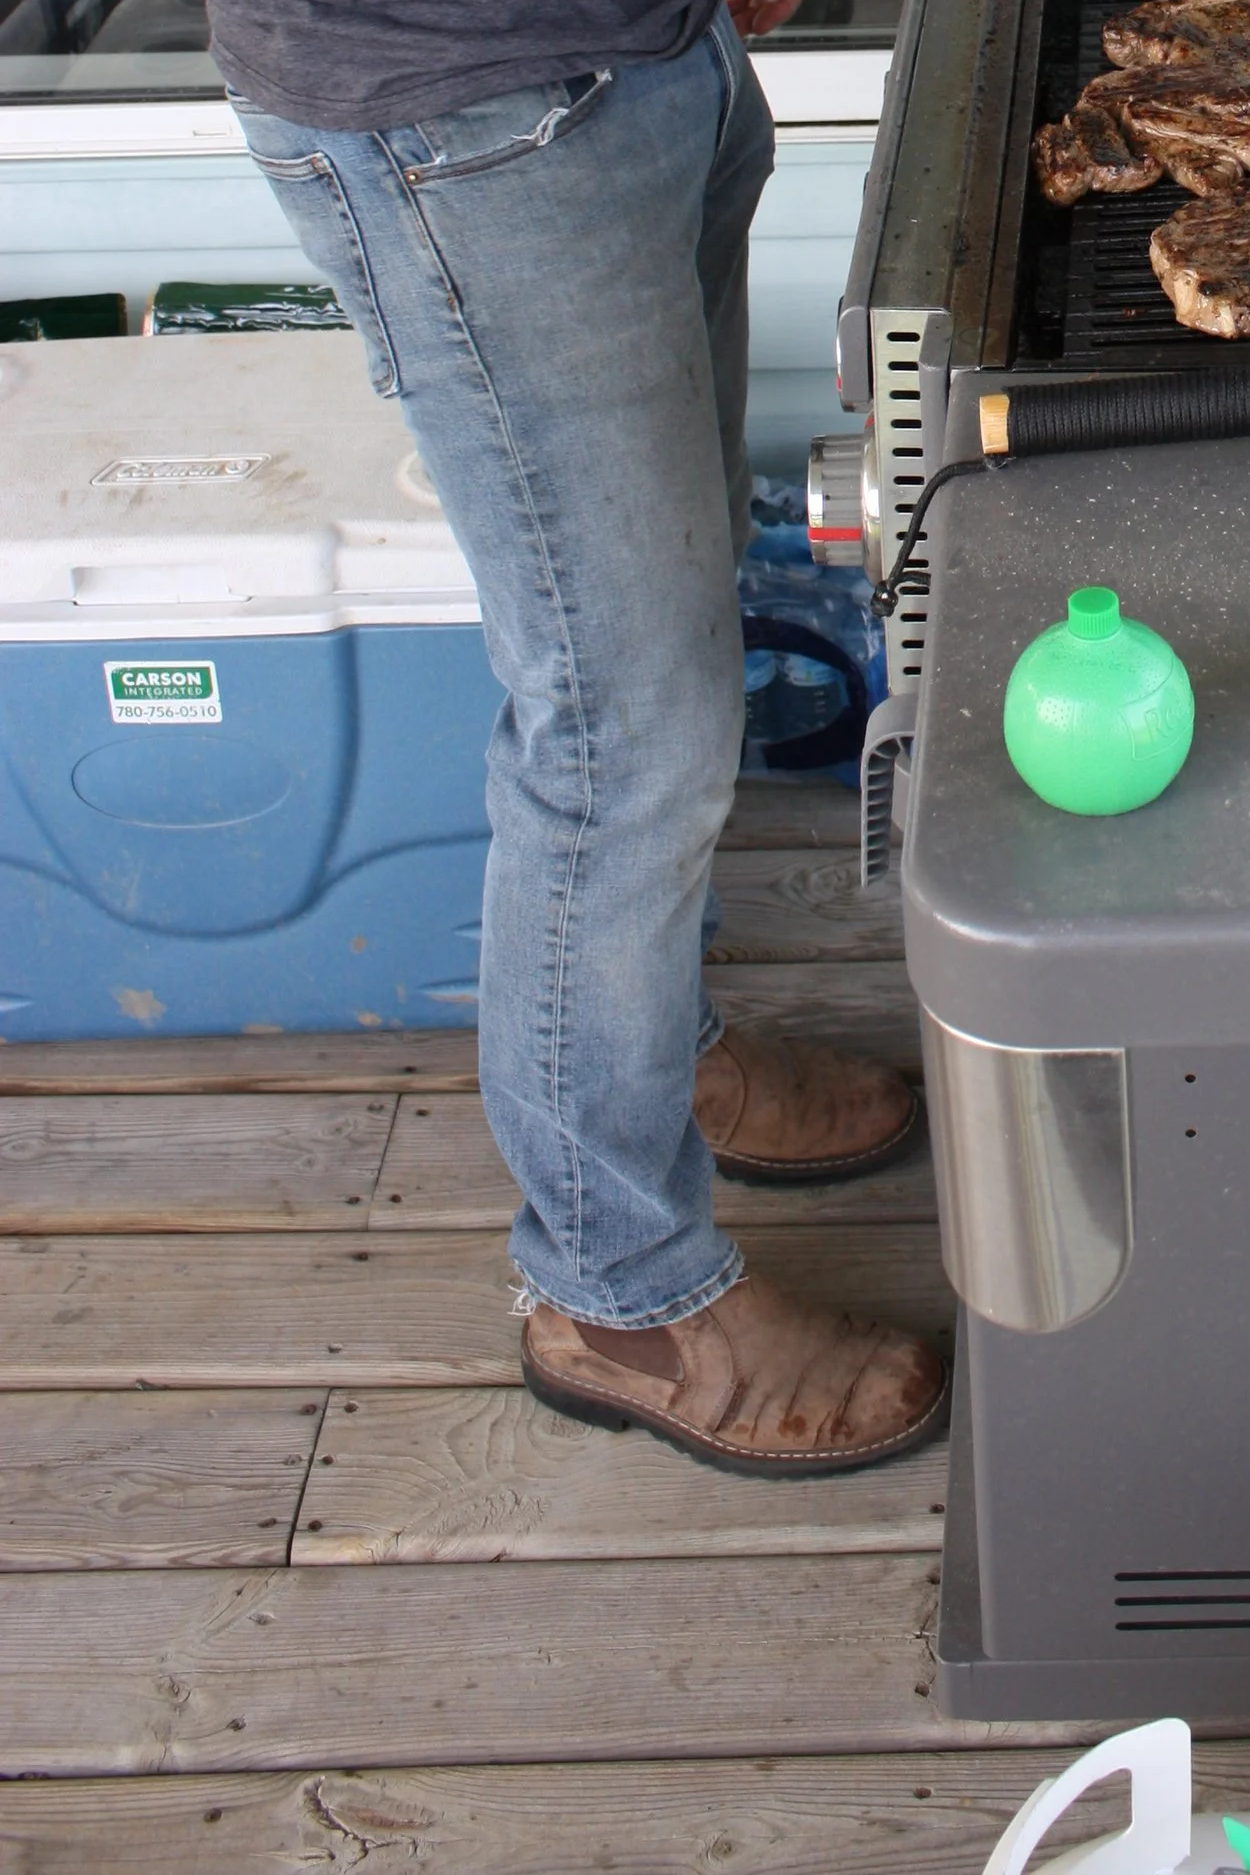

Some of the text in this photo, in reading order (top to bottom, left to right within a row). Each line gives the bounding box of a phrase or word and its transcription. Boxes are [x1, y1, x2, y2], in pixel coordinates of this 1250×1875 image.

[122, 672, 202, 686] CARSON
[124, 687, 203, 696] INTEGRATED
[116, 705, 217, 718] 780-756-0510
